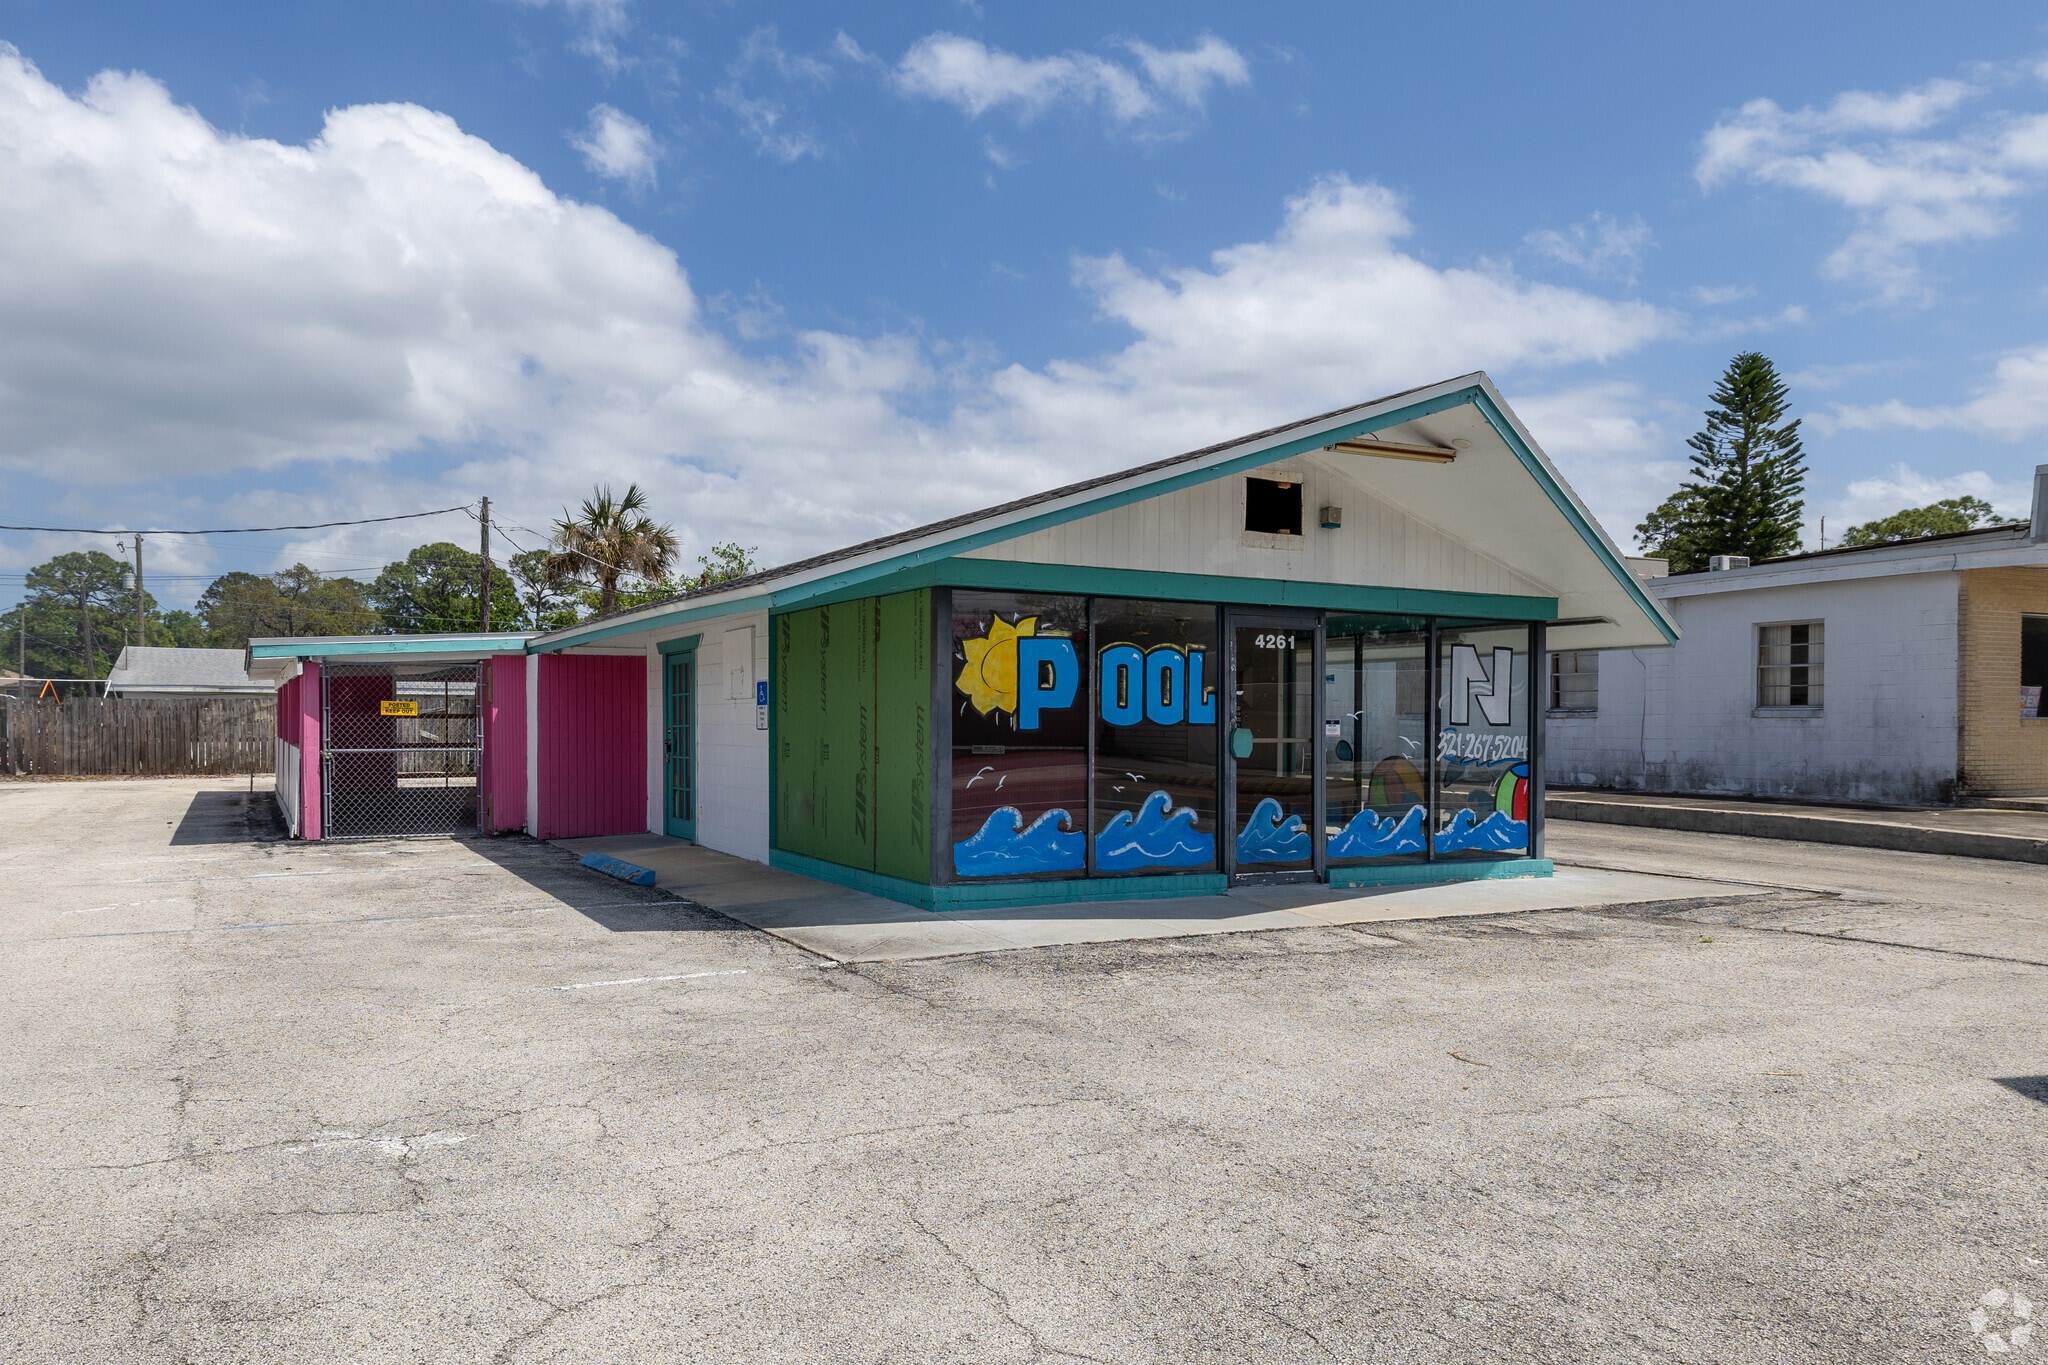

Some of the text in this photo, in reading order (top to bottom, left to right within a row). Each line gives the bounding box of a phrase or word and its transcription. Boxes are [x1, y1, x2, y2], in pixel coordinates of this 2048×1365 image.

[1017, 635, 1217, 732] POOL
[1255, 634, 1295, 650] 4261
[1449, 643, 1513, 726] N
